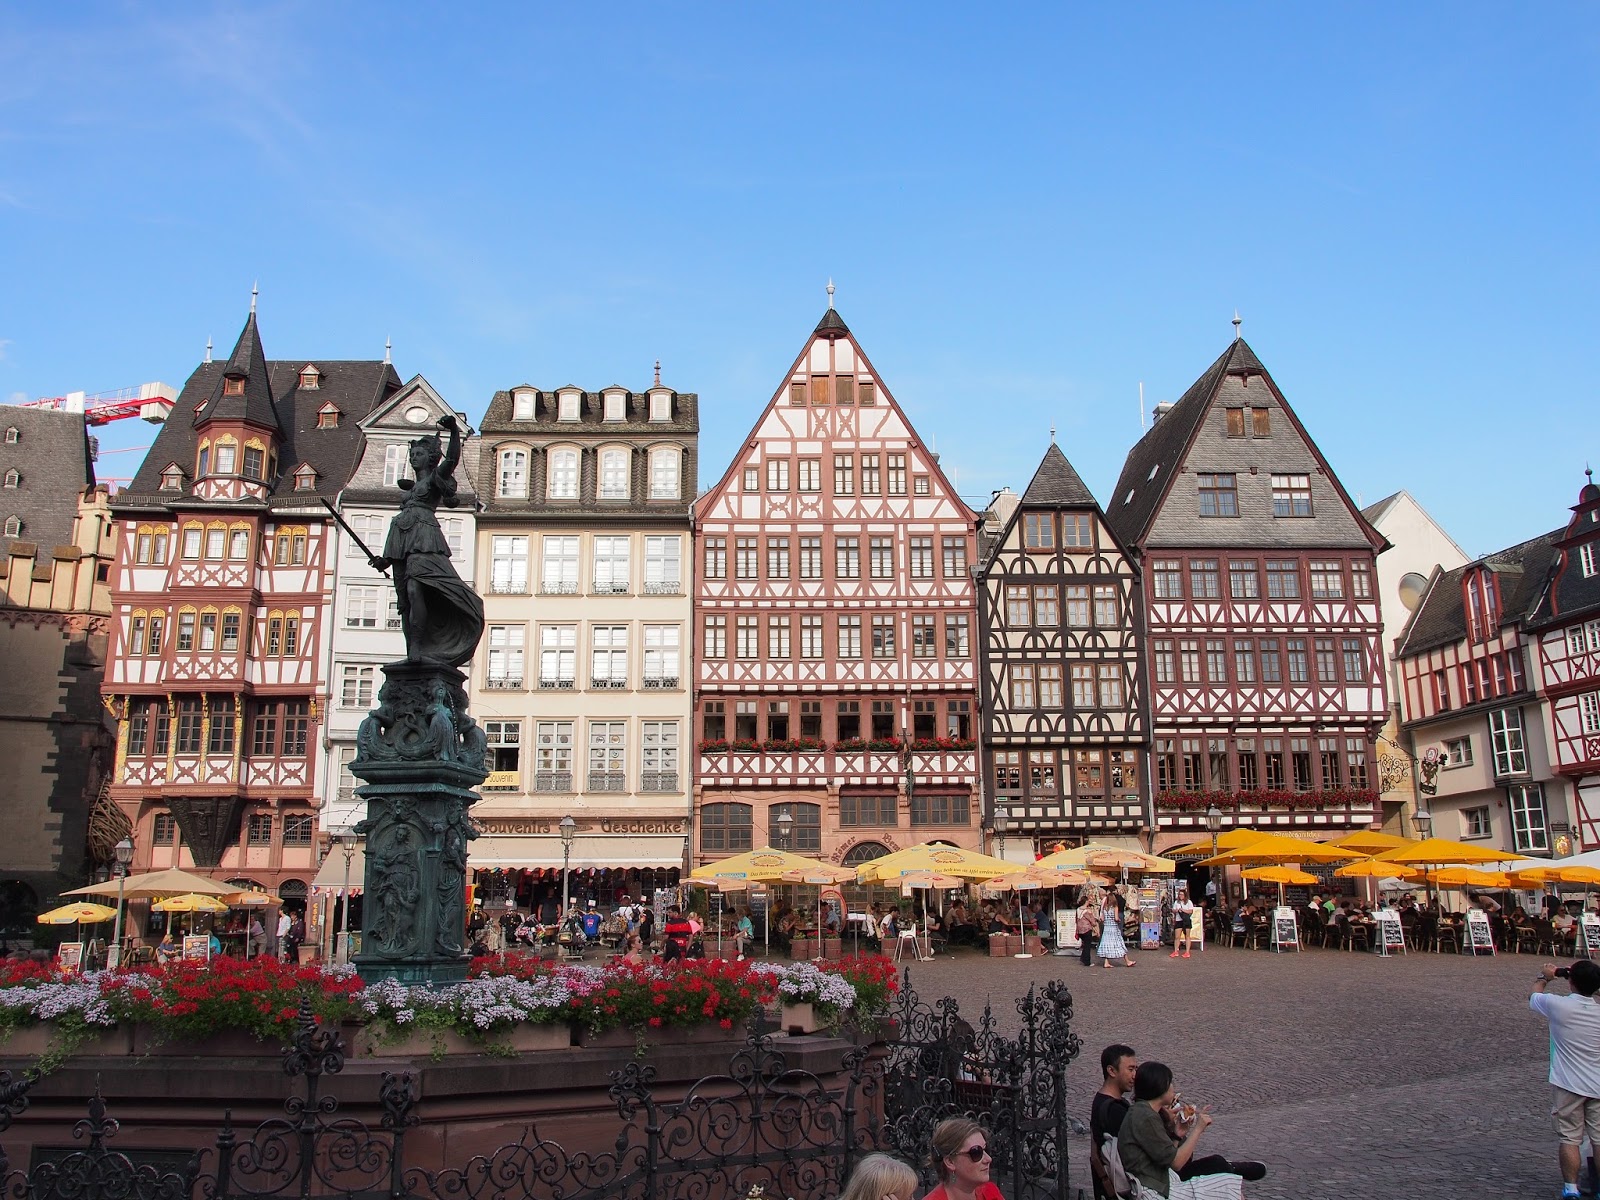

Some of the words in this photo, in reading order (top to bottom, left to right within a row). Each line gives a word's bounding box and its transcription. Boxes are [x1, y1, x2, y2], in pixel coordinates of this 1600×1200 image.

[489, 774, 513, 783] Souvenirs
[479, 821, 551, 834] Souvenirs
[601, 821, 682, 834] Geschenke
[830, 836, 856, 863] Römer
